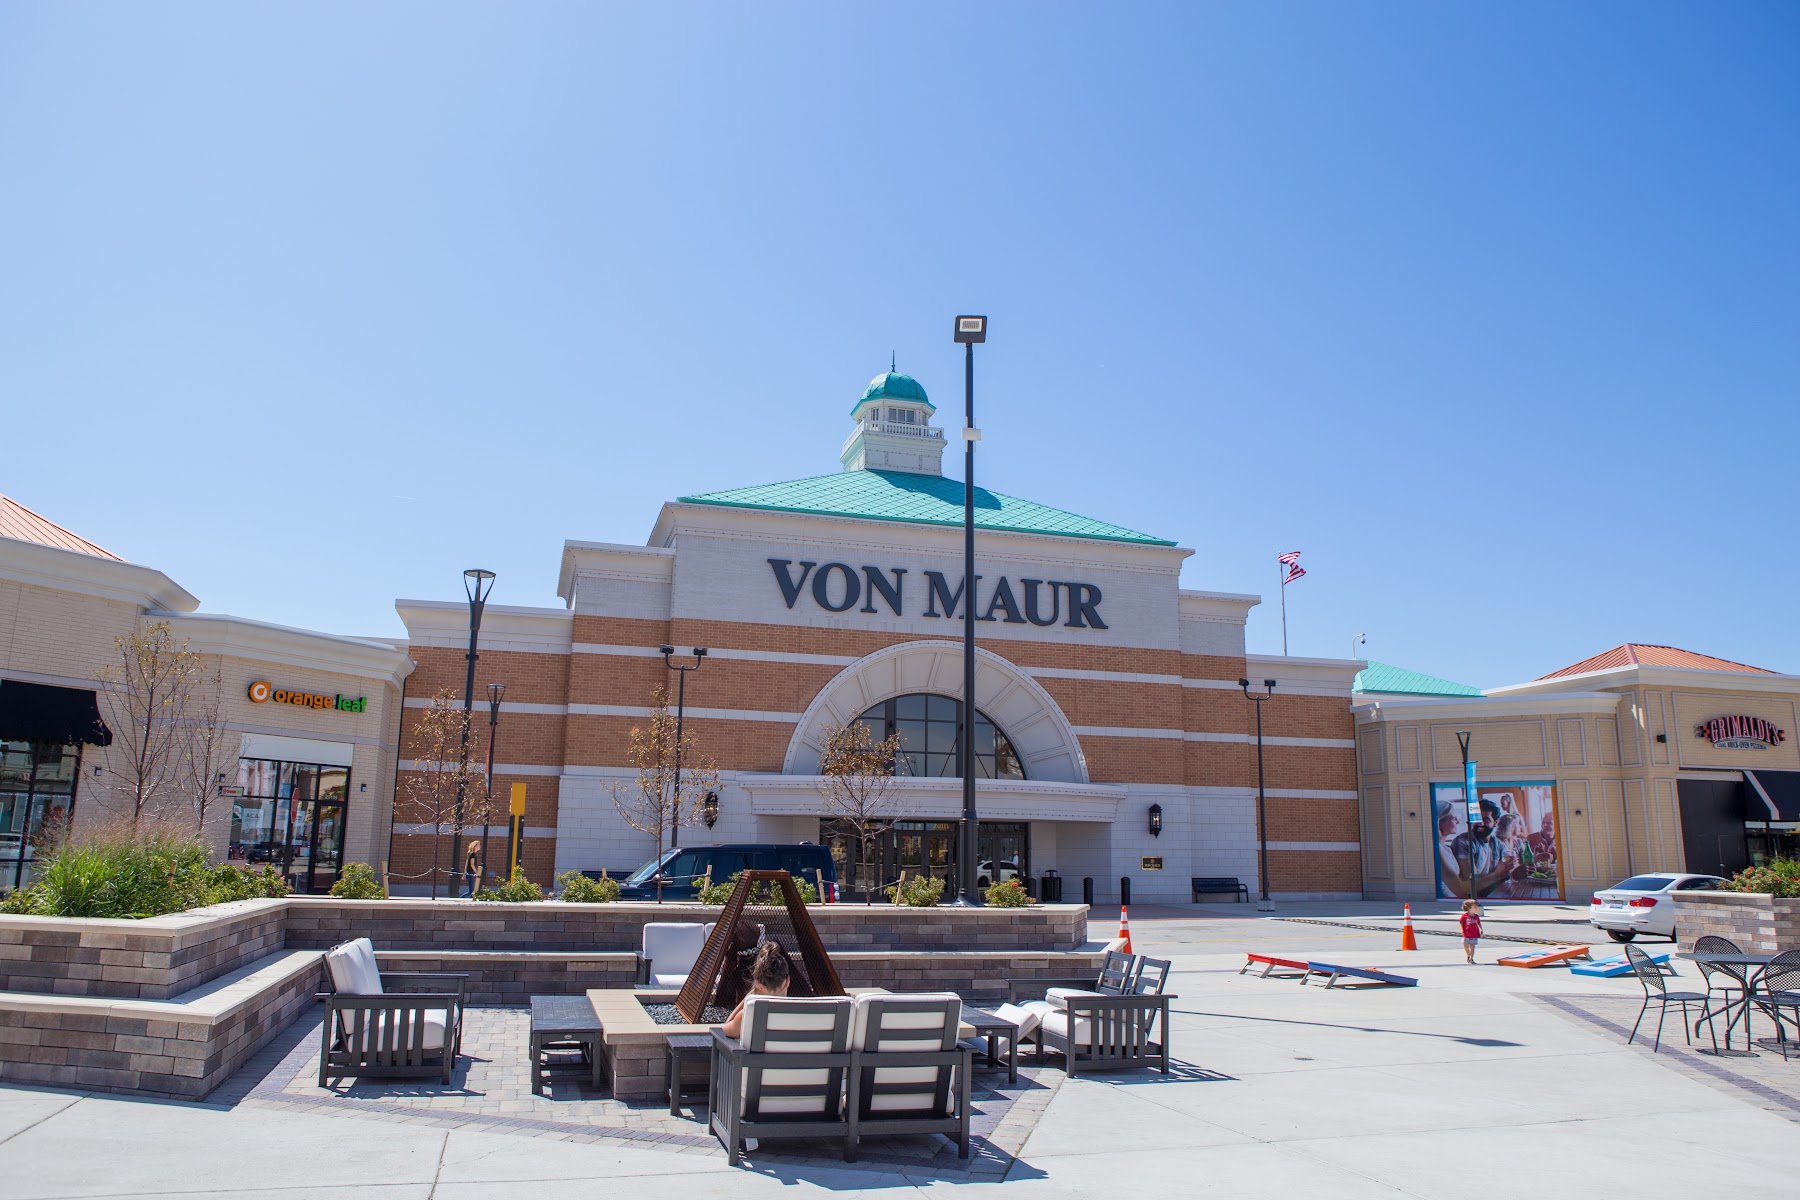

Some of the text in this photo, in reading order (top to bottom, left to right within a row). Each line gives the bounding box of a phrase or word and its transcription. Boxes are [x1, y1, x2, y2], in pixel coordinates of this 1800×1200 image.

[767, 558, 1109, 630] VON MAUR
[274, 689, 367, 713] orange leaf
[1710, 715, 1780, 746] GRIMALDI'S
